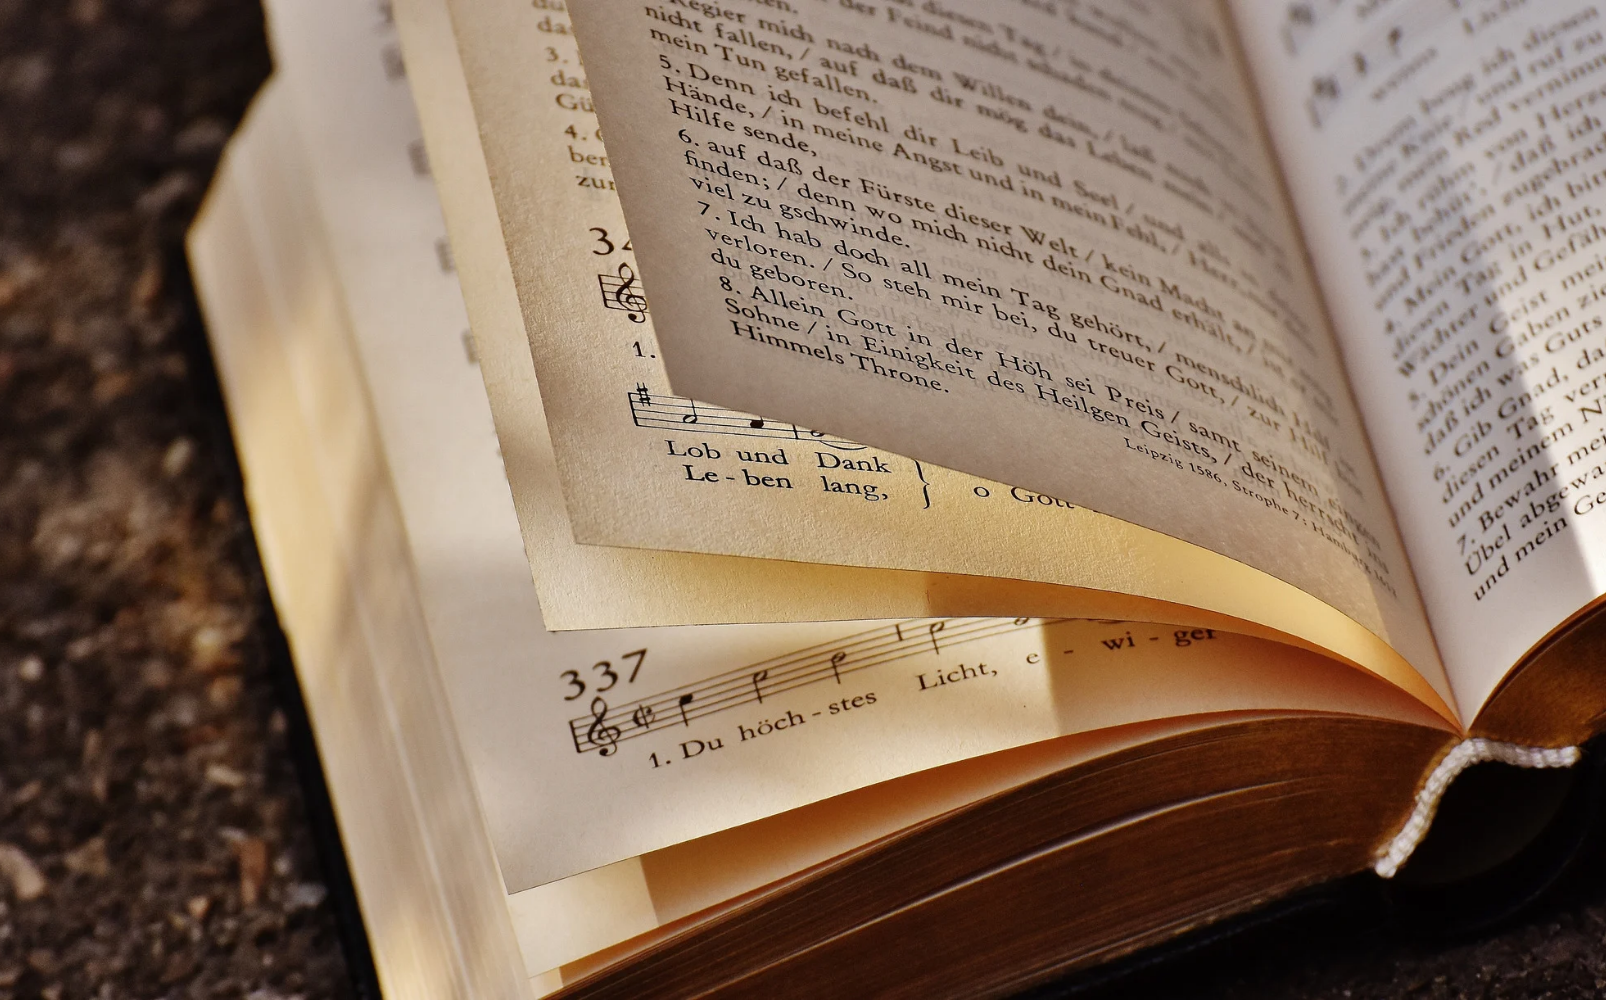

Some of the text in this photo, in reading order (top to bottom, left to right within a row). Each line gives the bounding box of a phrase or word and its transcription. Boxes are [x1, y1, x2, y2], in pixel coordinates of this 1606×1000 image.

[545, 46, 569, 64] 3.
[644, 6, 704, 33] nicht
[715, 23, 793, 61] fallen,
[820, 56, 858, 78] auf
[871, 68, 918, 95] daß
[930, 85, 964, 109] dir
[650, 27, 877, 104] mein Tun gefallen.
[758, 18, 815, 44] mich
[827, 37, 881, 62] nach
[891, 53, 942, 81] dem
[564, 124, 588, 141] 4.
[659, 54, 1119, 211] 5. Denn ich befehl dir Leib und Seel
[663, 74, 1108, 226] Hände, in meine Angst und in mein
[669, 98, 818, 157] Hilfe sende,
[678, 128, 1225, 324] 6. auf daß der Fürste dieser Welt kein Macht
[684, 149, 1242, 354] finden; denn wo mich nicht dein Gnad erhält,
[689, 176, 910, 249] viel zu gschwinde.
[697, 200, 721, 221] 7.
[727, 210, 766, 234] Ich
[775, 221, 822, 249] hab
[834, 240, 891, 268] doch
[900, 259, 932, 280] all
[943, 272, 1002, 300] mein
[1010, 288, 1061, 321] Tag
[1071, 312, 1151, 353] gehört,
[1175, 350, 1286, 418] menschlich
[711, 248, 854, 301] du geboren.
[632, 341, 656, 359] 1.
[704, 227, 815, 269] verloren.
[841, 262, 872, 284] So
[883, 277, 932, 300] steh
[941, 292, 984, 315] mir
[992, 302, 1038, 333] bei,
[1047, 321, 1078, 344] du
[1087, 337, 1156, 372] treuer
[1166, 363, 1225, 404] Gott,
[1247, 405, 1282, 432] zur
[729, 319, 950, 394] Himmels Throne.
[1545, 314, 1603, 355] Guts
[719, 275, 1319, 497] 8. Allein Gott in der Höh sei Preis samt seinem
[724, 298, 800, 332] Sohne
[825, 325, 851, 346] in
[860, 334, 977, 381] Einigkeit
[987, 371, 1025, 394] des
[1034, 382, 1131, 429] Heilgen
[1140, 420, 1218, 464] Geists,
[1241, 461, 1276, 490] der
[1283, 481, 1360, 546] herrscht
[1454, 419, 1494, 458] Gib
[1498, 367, 1570, 421] Gnad,
[664, 439, 892, 474] Lob und Dank
[682, 463, 720, 483] Le
[741, 468, 794, 489] ben
[820, 475, 889, 502] lang,
[973, 486, 990, 498] o
[1123, 436, 1184, 471] Leipzig
[1189, 462, 1228, 487] 1586,
[1232, 479, 1289, 515] Strophe
[1442, 445, 1500, 505] diesen
[1506, 405, 1556, 441] Tag
[1449, 480, 1486, 528] und
[1488, 421, 1573, 491] meinem
[1477, 462, 1560, 533] Bewahr
[1464, 523, 1511, 577] Übel
[1473, 554, 1511, 602] und
[1515, 515, 1568, 563] mein
[559, 647, 649, 702] 337
[648, 752, 672, 770] 1.
[679, 737, 725, 761] Du
[737, 709, 806, 743] höch
[829, 691, 878, 715] stes
[914, 662, 998, 693] Licht,
[1102, 631, 1136, 651] wi
[1173, 627, 1217, 648] ger
